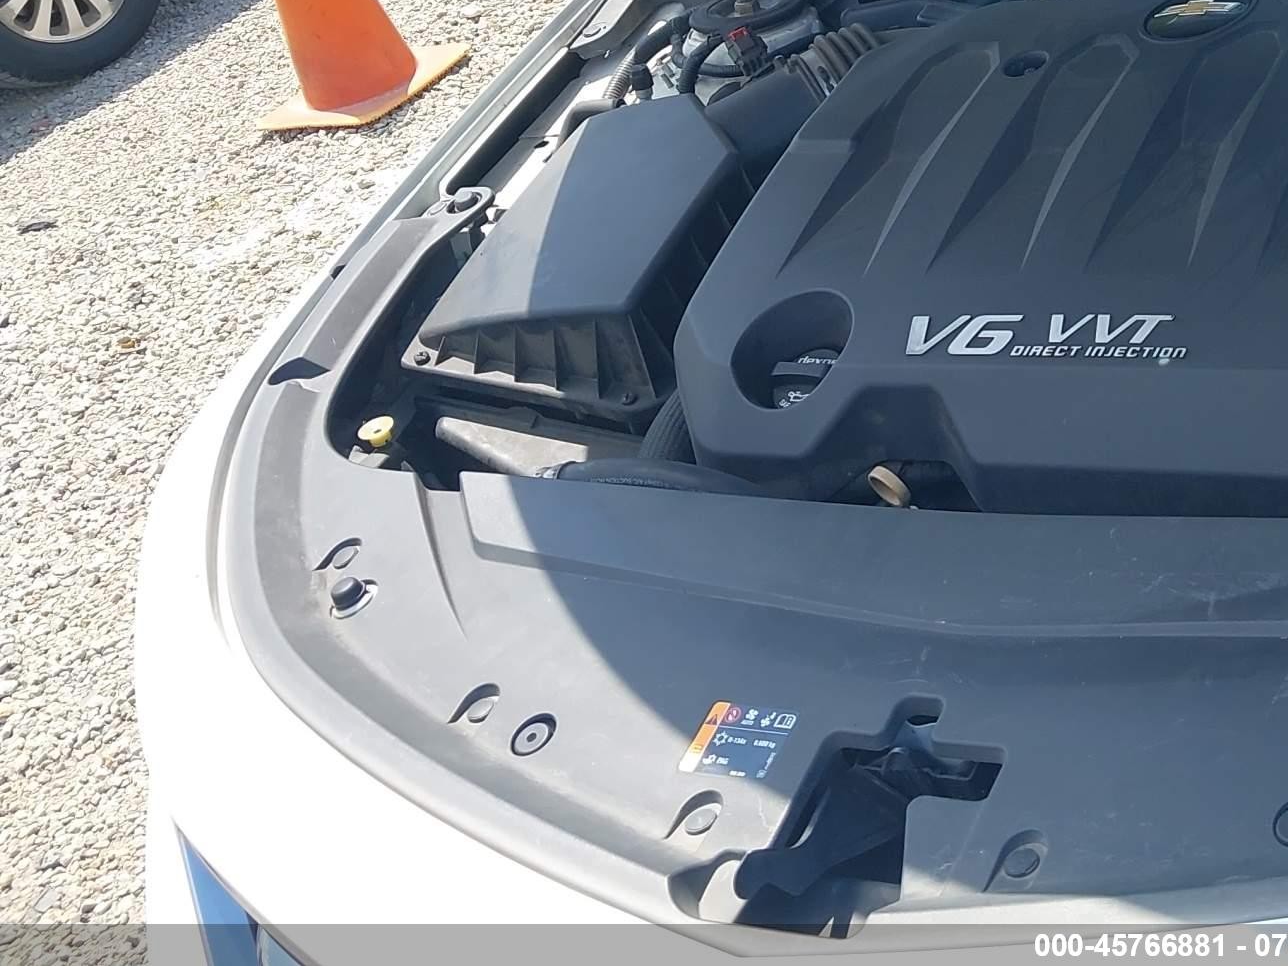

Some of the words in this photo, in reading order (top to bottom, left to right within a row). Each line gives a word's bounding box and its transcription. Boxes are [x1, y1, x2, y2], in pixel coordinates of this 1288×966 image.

[905, 314, 1024, 356] V6
[1047, 313, 1176, 344] VVT
[1009, 345, 1083, 358] DIRECT
[1084, 345, 1188, 359] INJECTION
